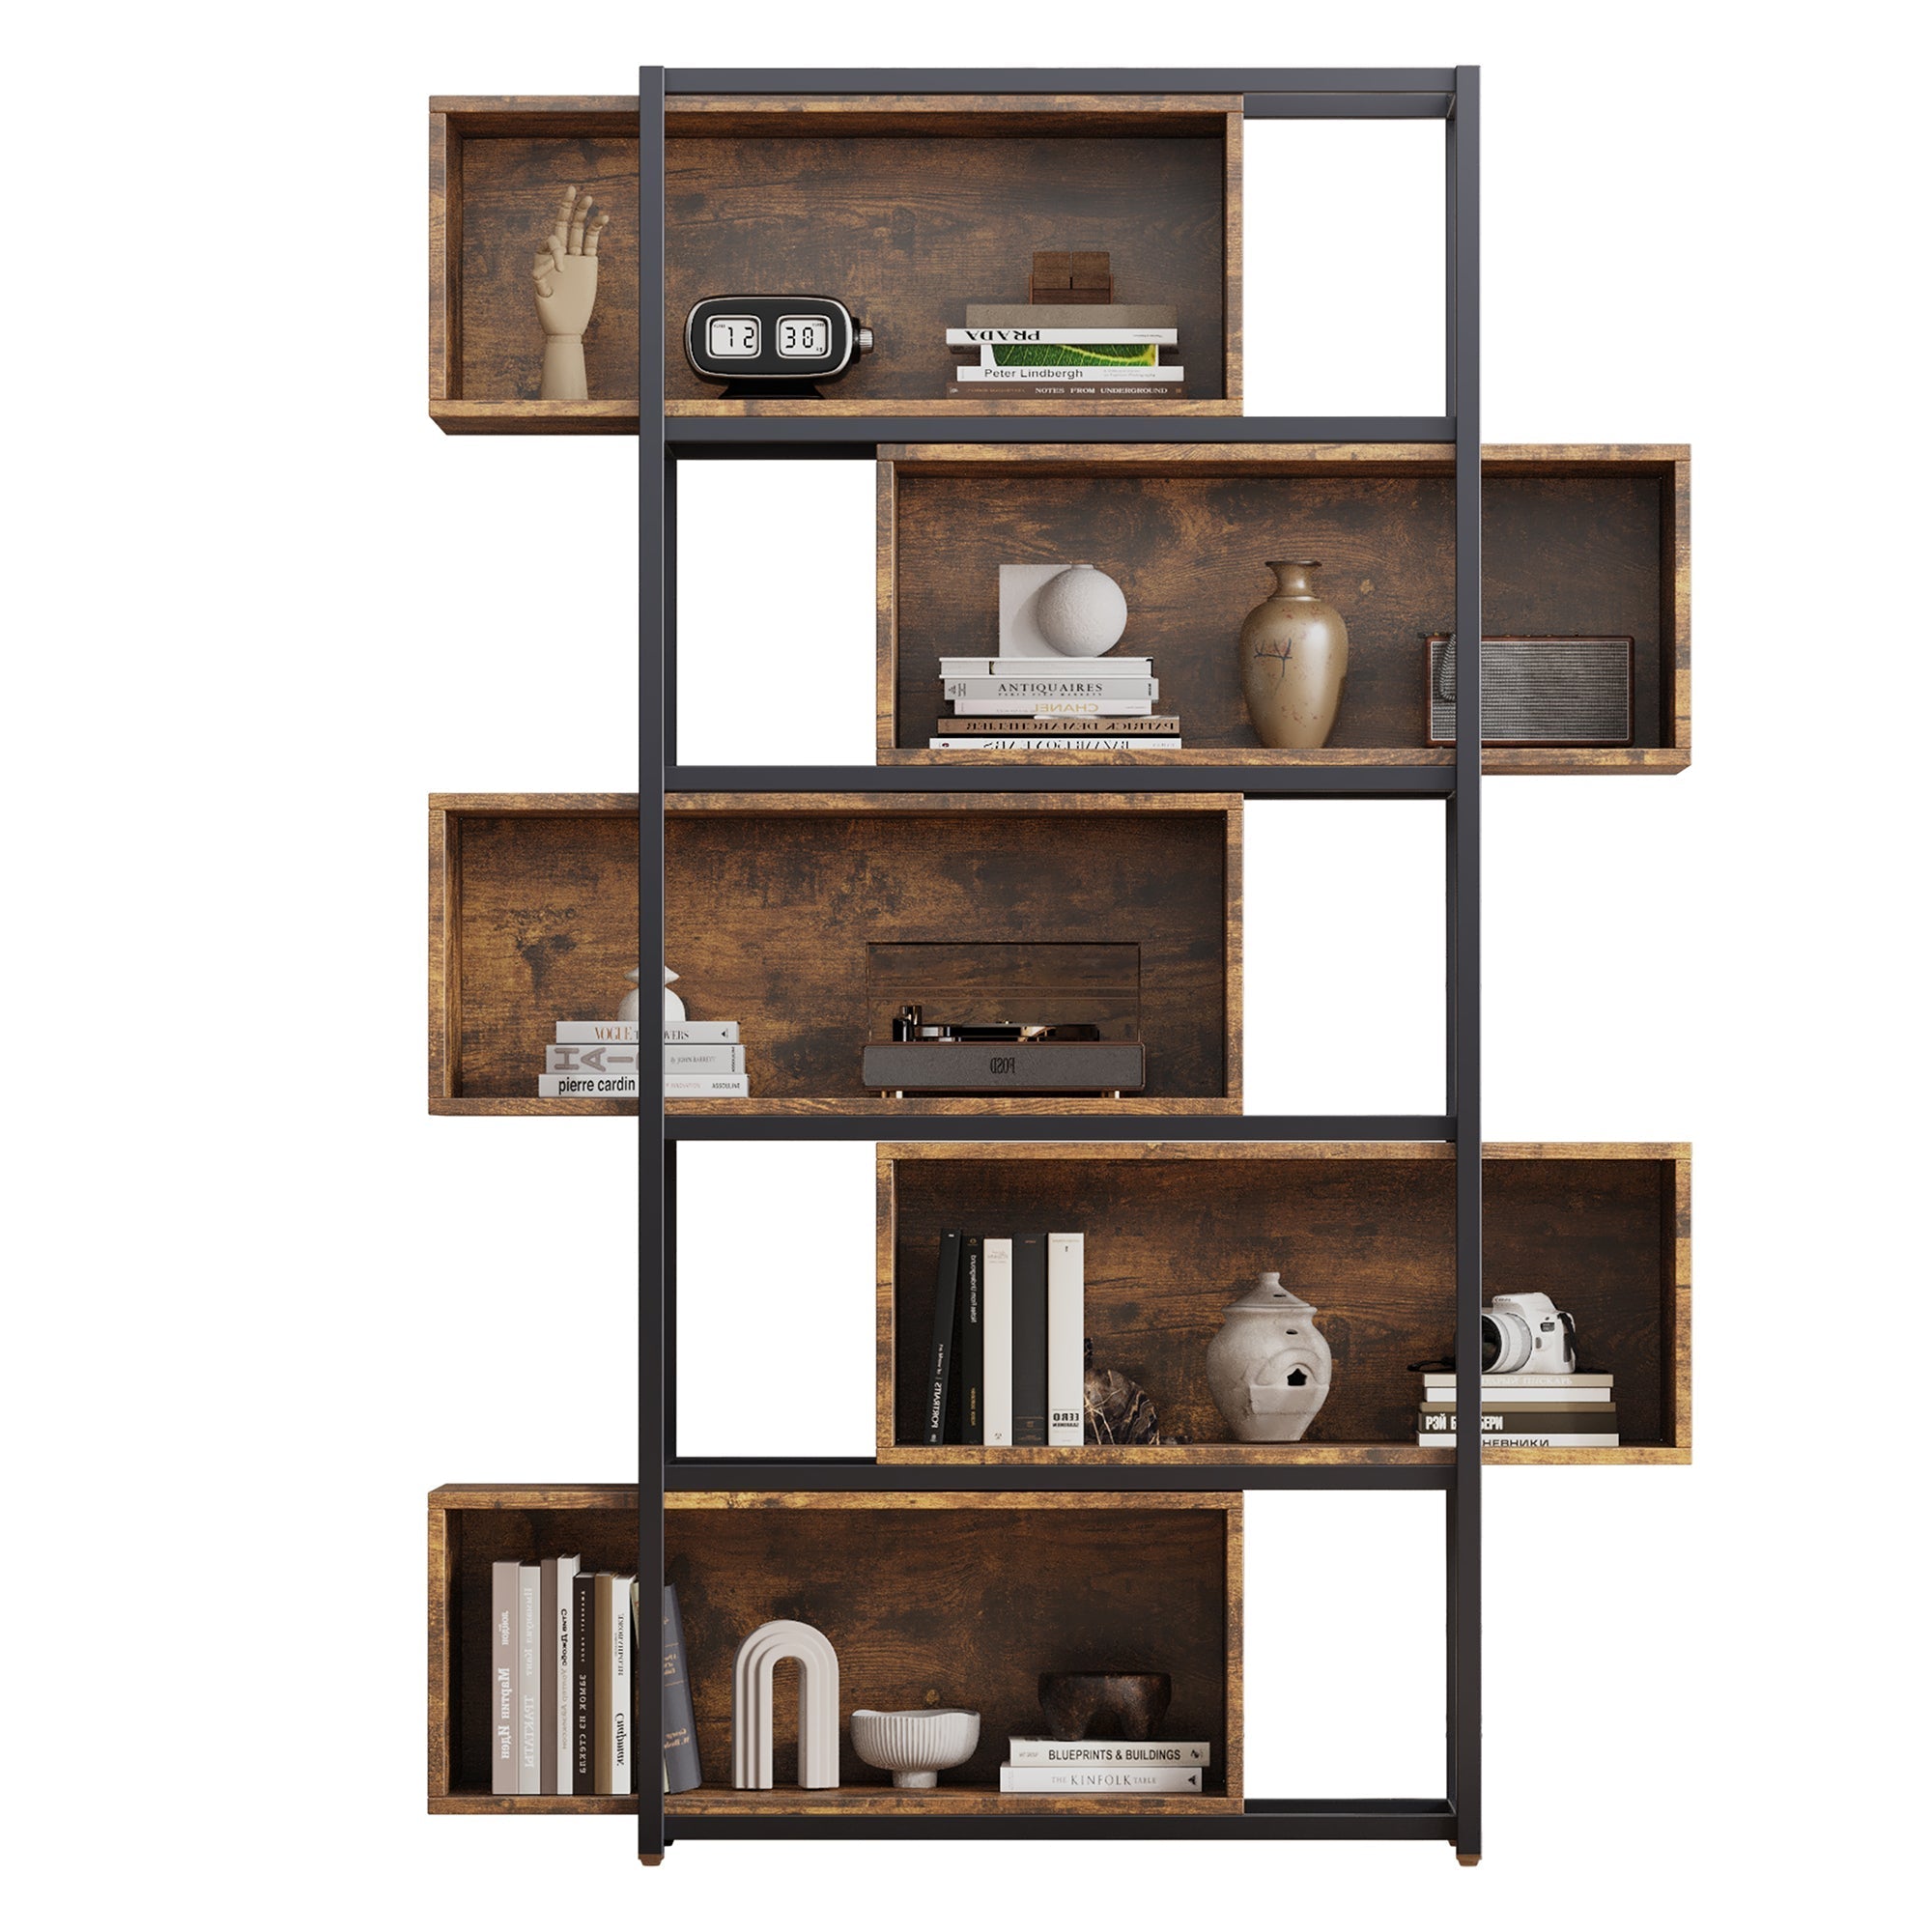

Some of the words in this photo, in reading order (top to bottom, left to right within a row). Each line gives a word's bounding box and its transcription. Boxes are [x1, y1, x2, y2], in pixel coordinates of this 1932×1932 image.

[785, 327, 814, 349] 30
[965, 329, 1040, 341] PRADA
[984, 368, 1016, 379] Peter
[1020, 368, 1084, 381] Lindbergh
[998, 683, 1104, 693] ANTIQUAIRES
[595, 1027, 633, 1039] VOGUE
[554, 1047, 639, 1072] HAI
[558, 1077, 594, 1094] pierre
[597, 1076, 636, 1092] cardin
[1425, 1413, 1447, 1430] РЭЙ
[1482, 1438, 1549, 1447] НЕВНИКИ
[1048, 1749, 1113, 1761] BLUEPRINTS
[1115, 1749, 1122, 1761] &
[1125, 1749, 1181, 1761] BUILDINGS
[1070, 1774, 1132, 1786] KINFOLK
